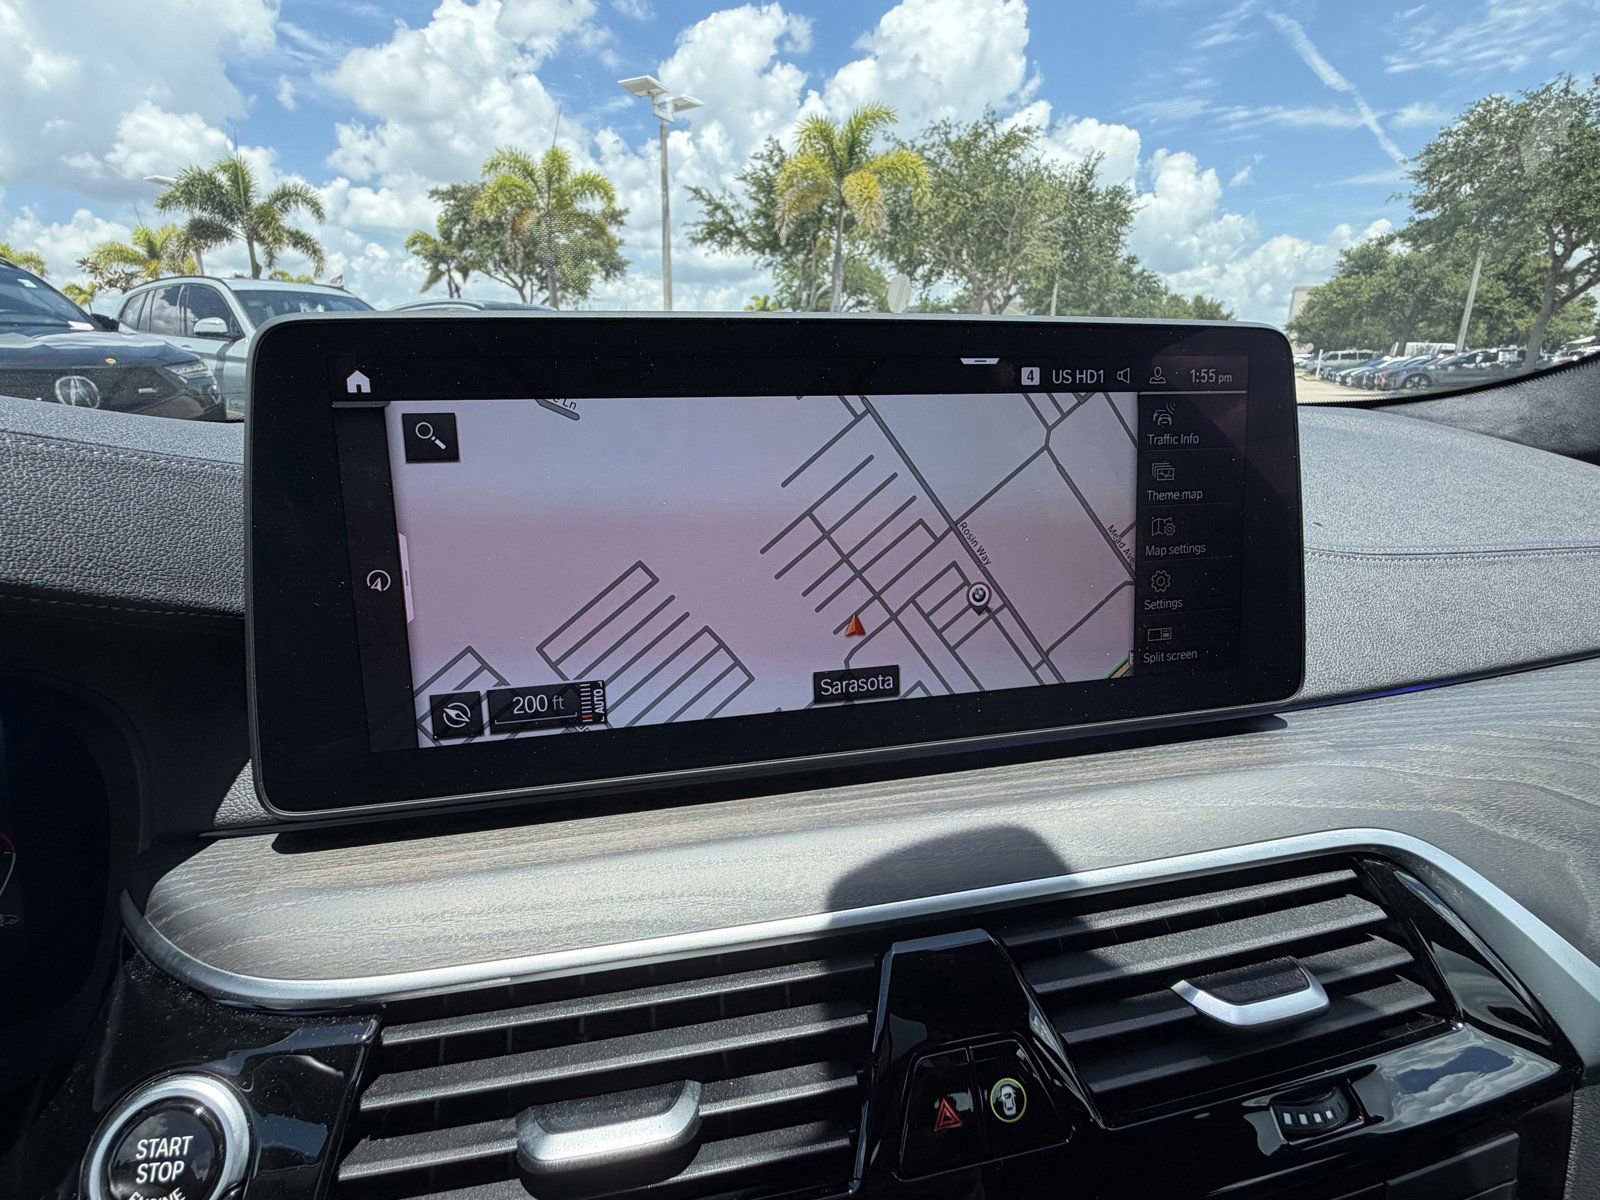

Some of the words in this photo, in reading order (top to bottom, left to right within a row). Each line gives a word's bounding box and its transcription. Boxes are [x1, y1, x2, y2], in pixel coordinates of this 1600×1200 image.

[1026, 370, 1035, 382] 4
[1052, 371, 1072, 384] US
[1076, 371, 1104, 384] HD1
[1190, 368, 1216, 383] 1:55
[1218, 373, 1233, 384] pm
[1147, 433, 1179, 446] Traffic
[1180, 433, 1200, 445] Info
[1146, 490, 1180, 502] Theme
[1182, 490, 1203, 503] map
[960, 521, 979, 548] Rosin
[976, 545, 992, 566] Way
[1107, 524, 1126, 549] Mead
[1123, 548, 1136, 564] Ave
[1145, 545, 1167, 558] Map
[1169, 543, 1207, 557] settings
[1143, 598, 1184, 612] Settings
[1142, 652, 1165, 665] Split
[1166, 649, 1198, 662] screen
[820, 674, 894, 696] Sarasota
[512, 694, 548, 715] 200
[552, 695, 565, 710] ft
[593, 688, 605, 714] AUTO
[135, 1135, 193, 1161] START
[135, 1160, 185, 1184] STOP
